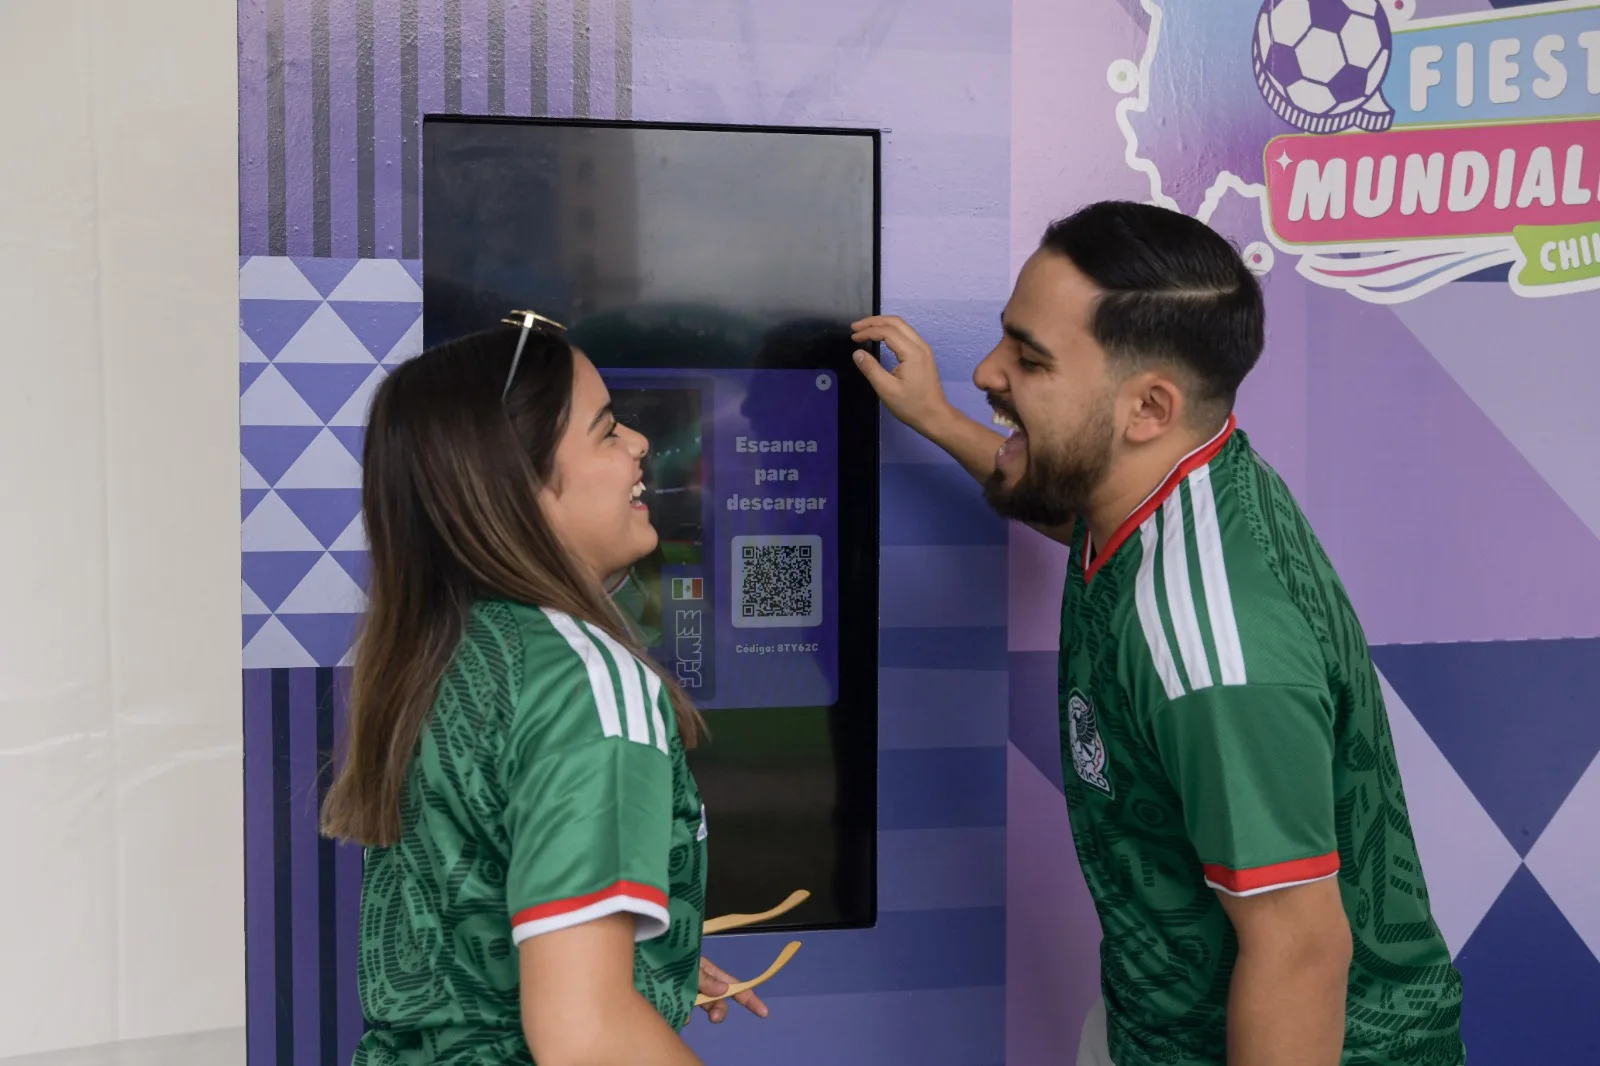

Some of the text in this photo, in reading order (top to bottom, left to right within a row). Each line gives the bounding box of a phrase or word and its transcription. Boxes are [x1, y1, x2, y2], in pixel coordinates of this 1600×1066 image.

[1287, 144, 1600, 222] MUNDIAL
[736, 436, 818, 453] Escanea
[755, 468, 799, 486] para
[726, 493, 827, 514] descargar
[735, 643, 819, 655] Código: 8TY62C
